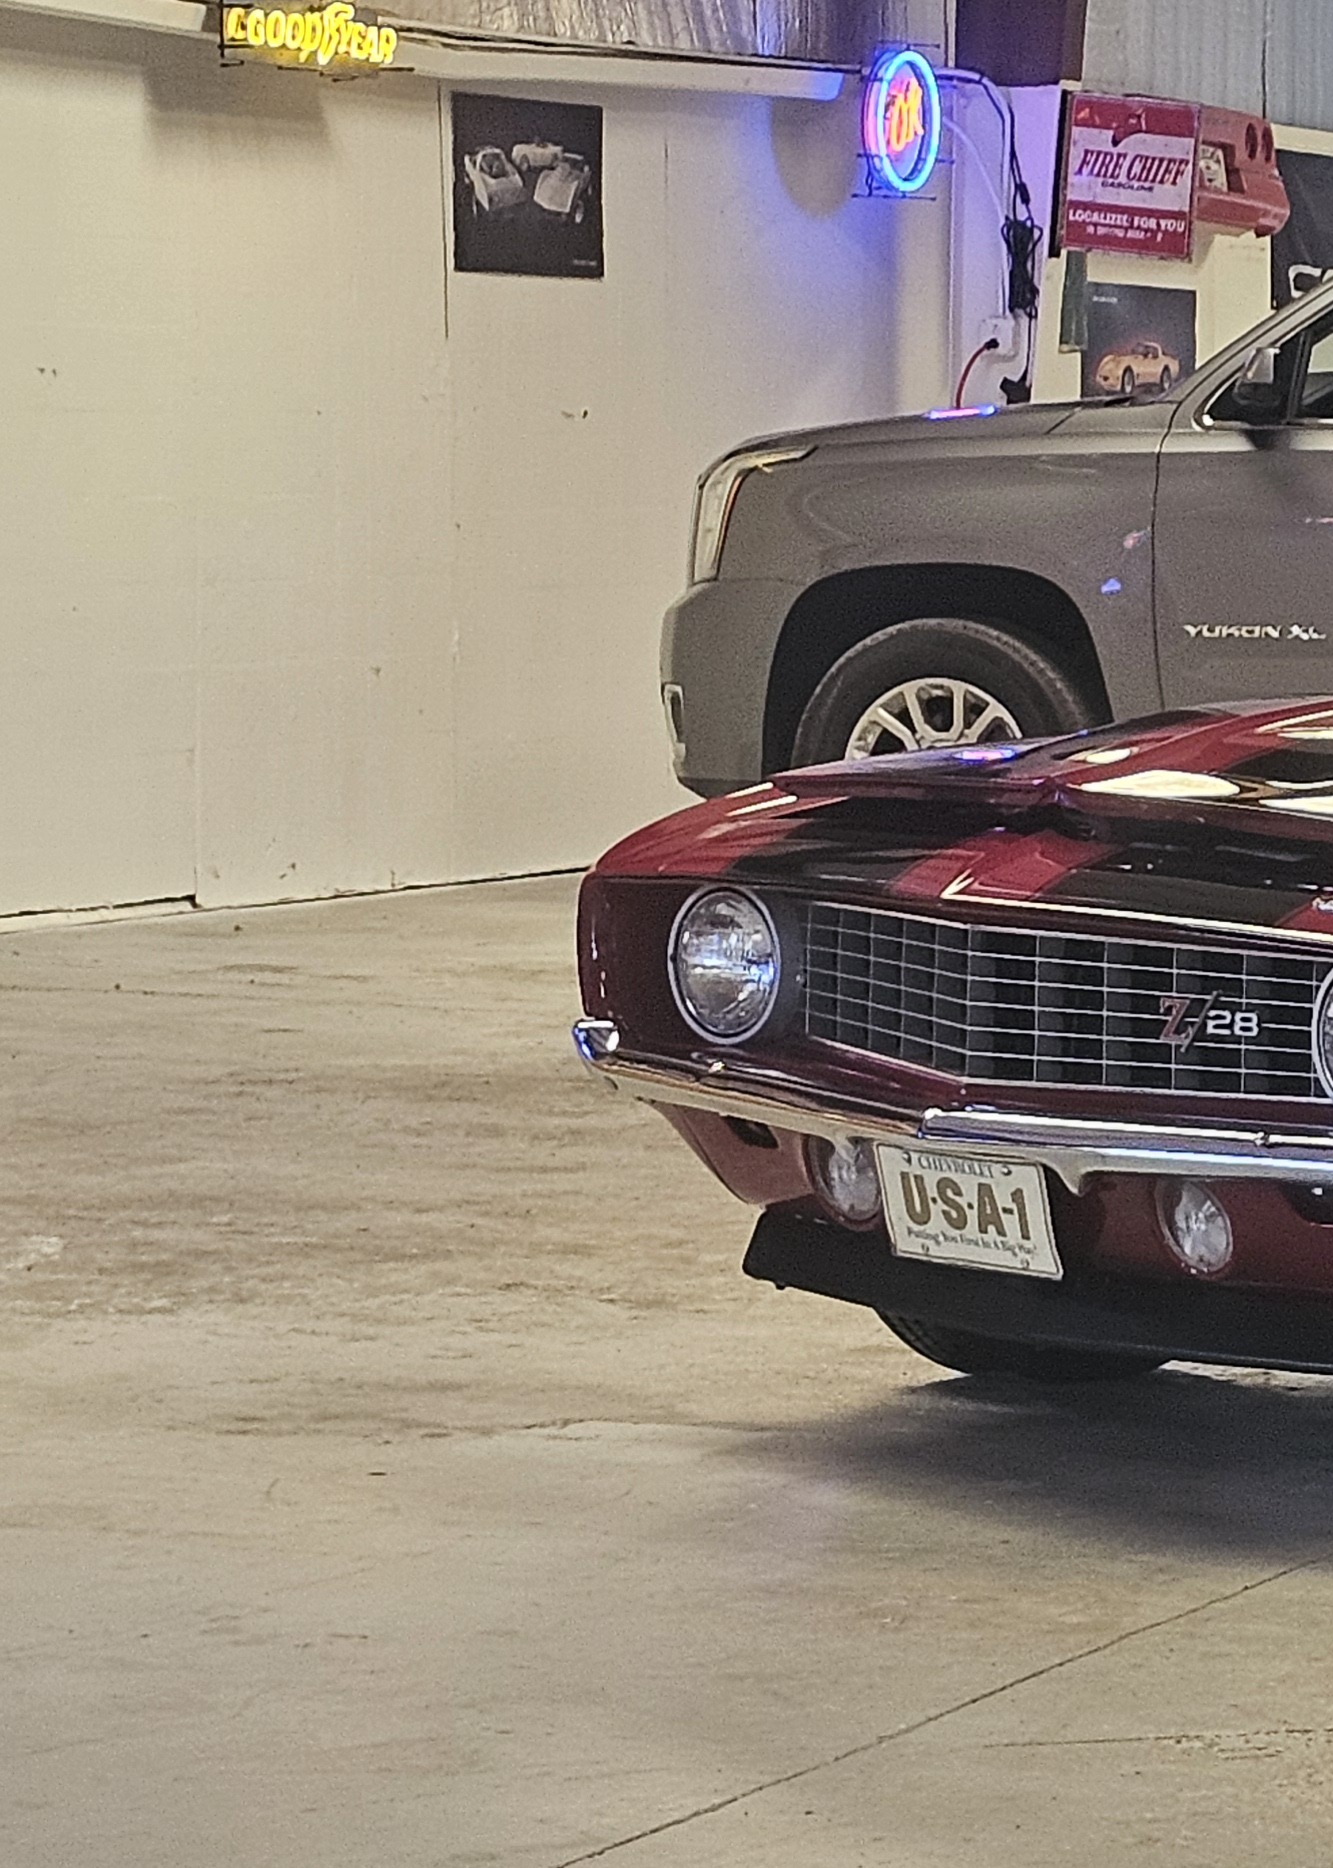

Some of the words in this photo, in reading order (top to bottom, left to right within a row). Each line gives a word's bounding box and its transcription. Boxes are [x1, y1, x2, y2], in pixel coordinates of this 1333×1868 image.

[1074, 149, 1127, 179] FIRE
[1126, 154, 1190, 187] CHIEF
[1159, 219, 1185, 233] YOU
[1183, 624, 1283, 638] YUKON
[1287, 624, 1327, 641] XL
[1160, 989, 1260, 1053] Z/28
[918, 1154, 995, 1179] CHEVROLET
